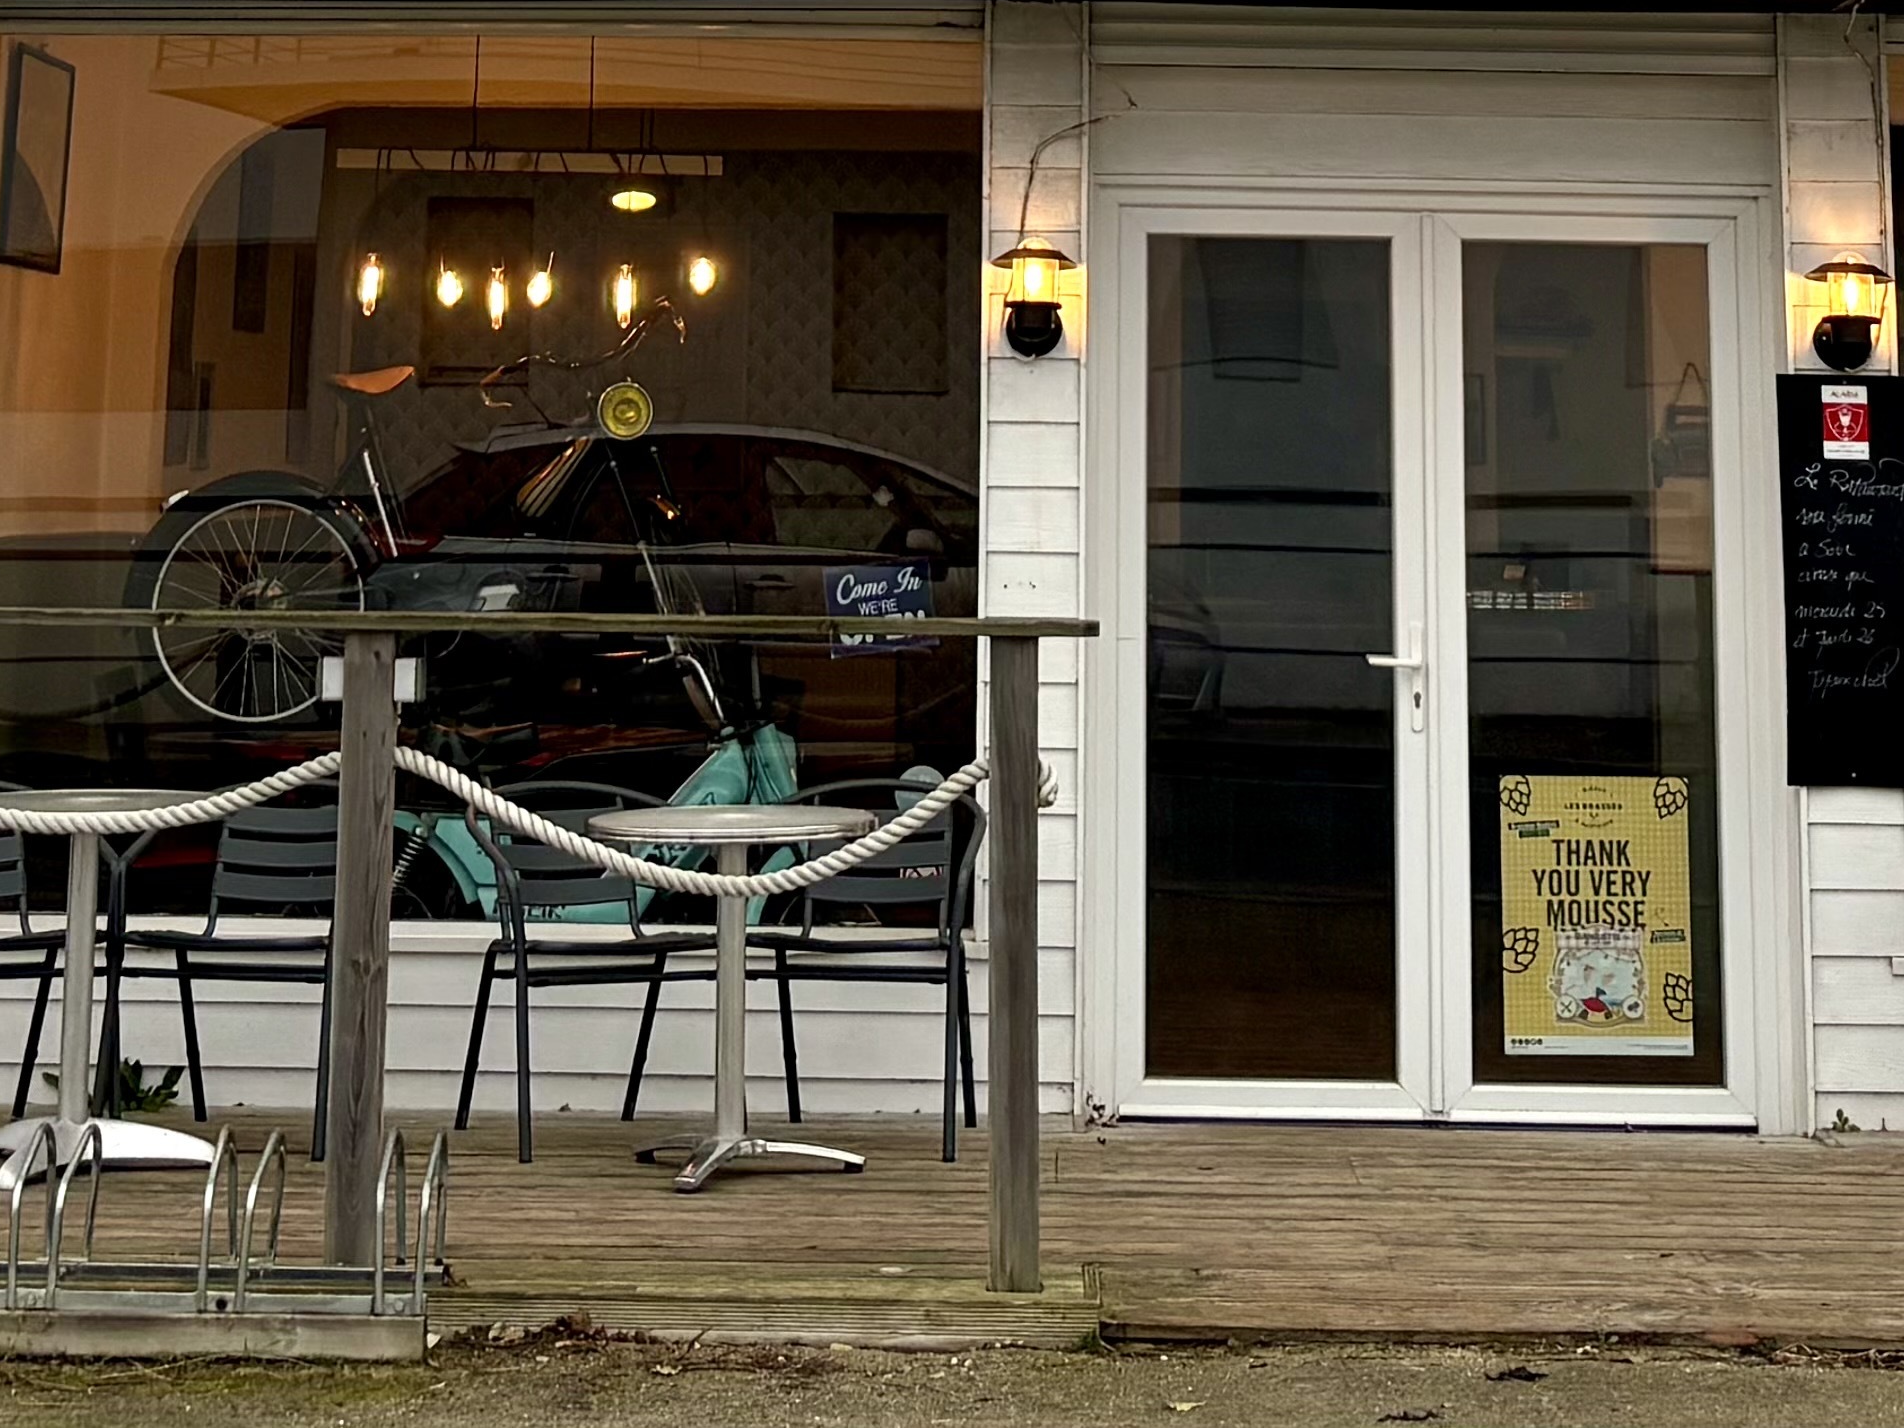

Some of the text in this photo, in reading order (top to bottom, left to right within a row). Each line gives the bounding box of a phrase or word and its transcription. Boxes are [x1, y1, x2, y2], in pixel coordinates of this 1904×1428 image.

[836, 566, 923, 605] Come In
[857, 598, 898, 616] WE'RE
[1551, 839, 1631, 867] THANK
[1532, 869, 1651, 897] YOU VERY
[1547, 899, 1646, 928] MOUSSE
